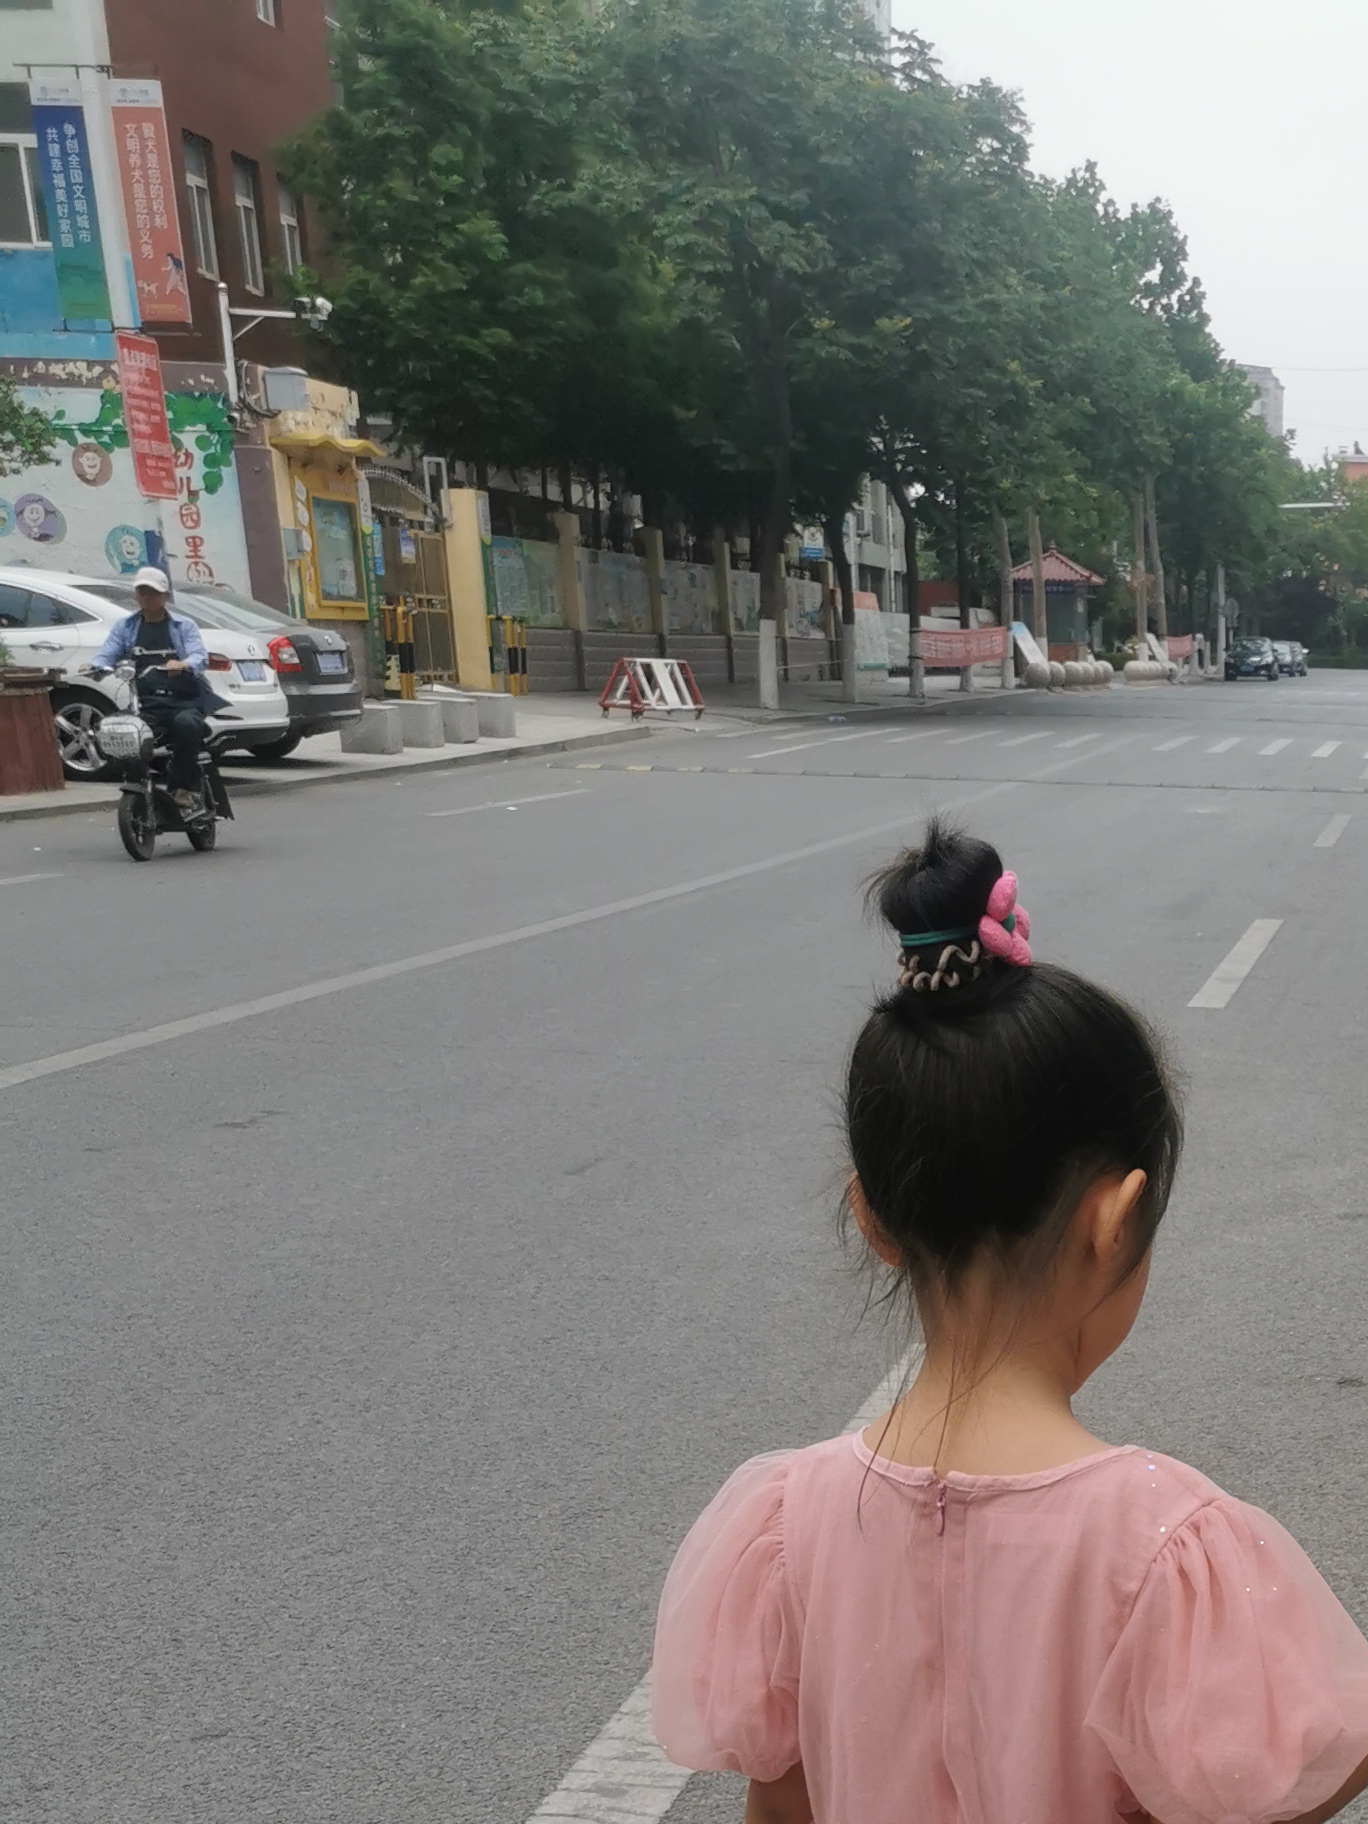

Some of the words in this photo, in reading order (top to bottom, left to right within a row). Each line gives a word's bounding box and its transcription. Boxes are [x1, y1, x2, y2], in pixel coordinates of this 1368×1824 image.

[46, 127, 75, 248] 共建幸福美好家园
[63, 121, 91, 243] 争创全国文明城市
